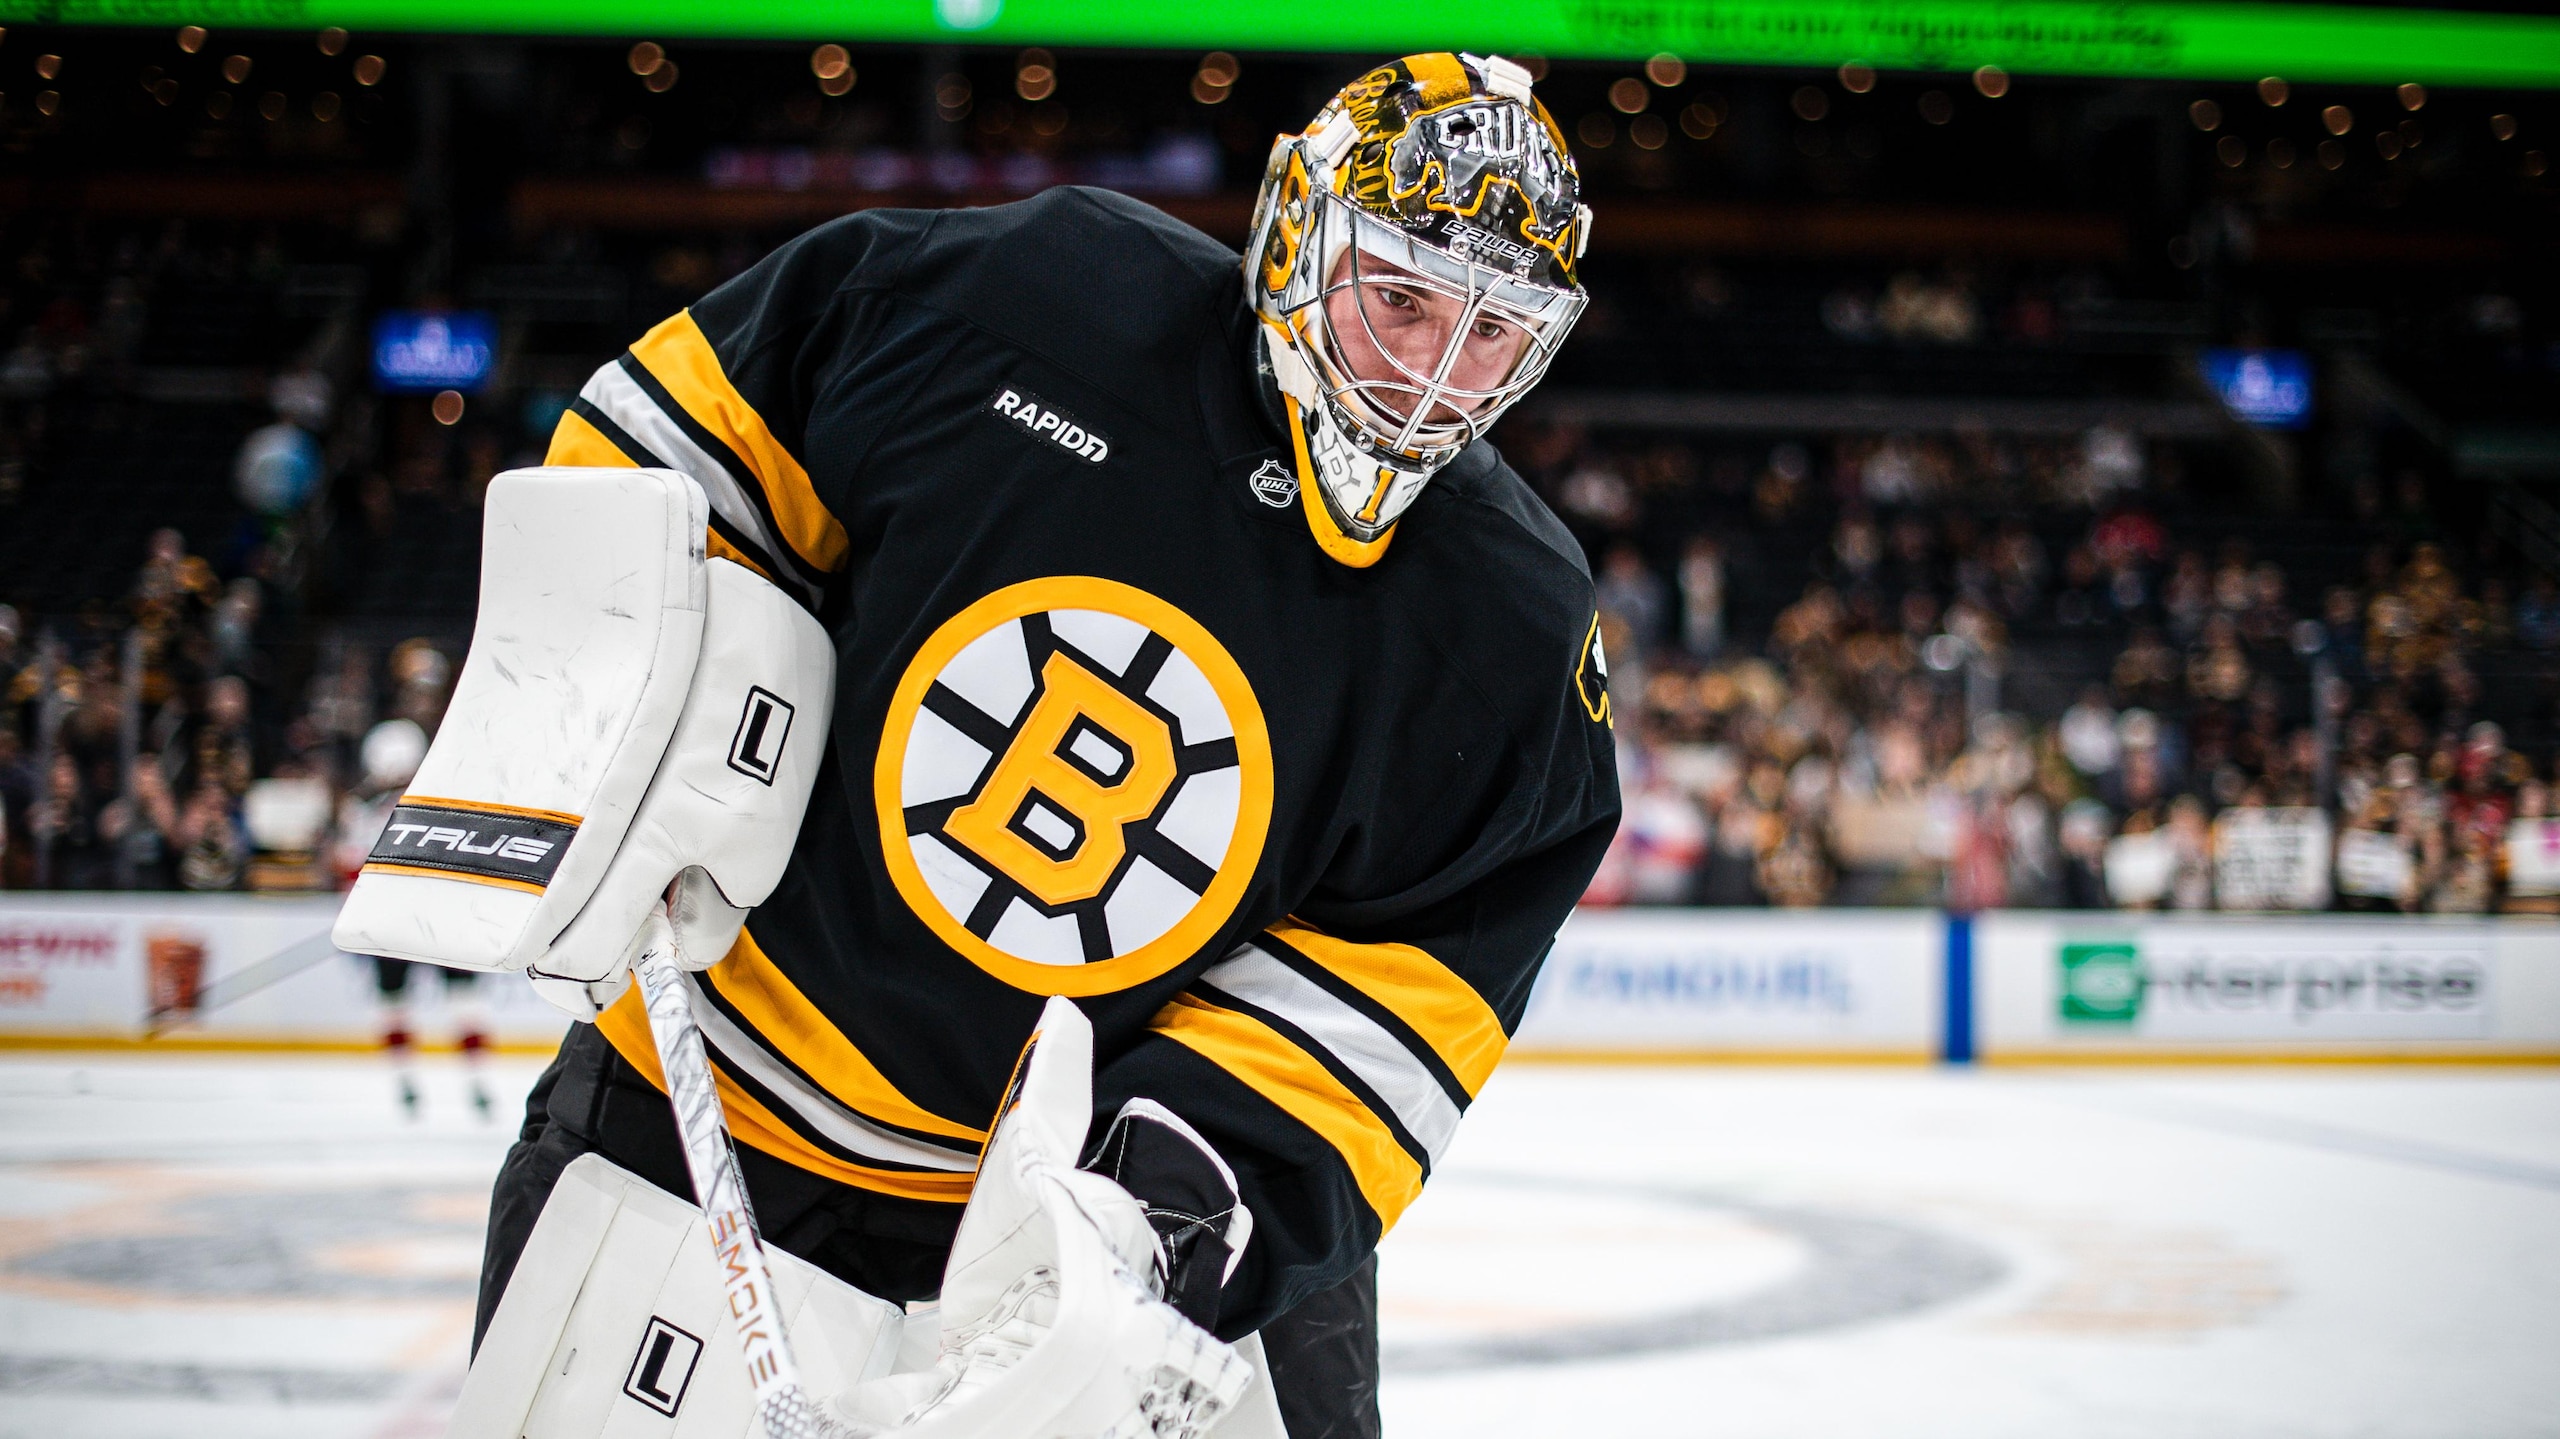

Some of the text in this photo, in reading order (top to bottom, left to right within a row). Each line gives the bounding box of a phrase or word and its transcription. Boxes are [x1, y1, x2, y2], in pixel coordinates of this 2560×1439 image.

[1441, 220, 1540, 268] BAUER
[993, 389, 1108, 463] RAPID7
[1258, 479, 1290, 491] NHL
[942, 649, 1177, 906] B
[388, 823, 554, 863] TRUE
[708, 1210, 779, 1390] SMOKE
